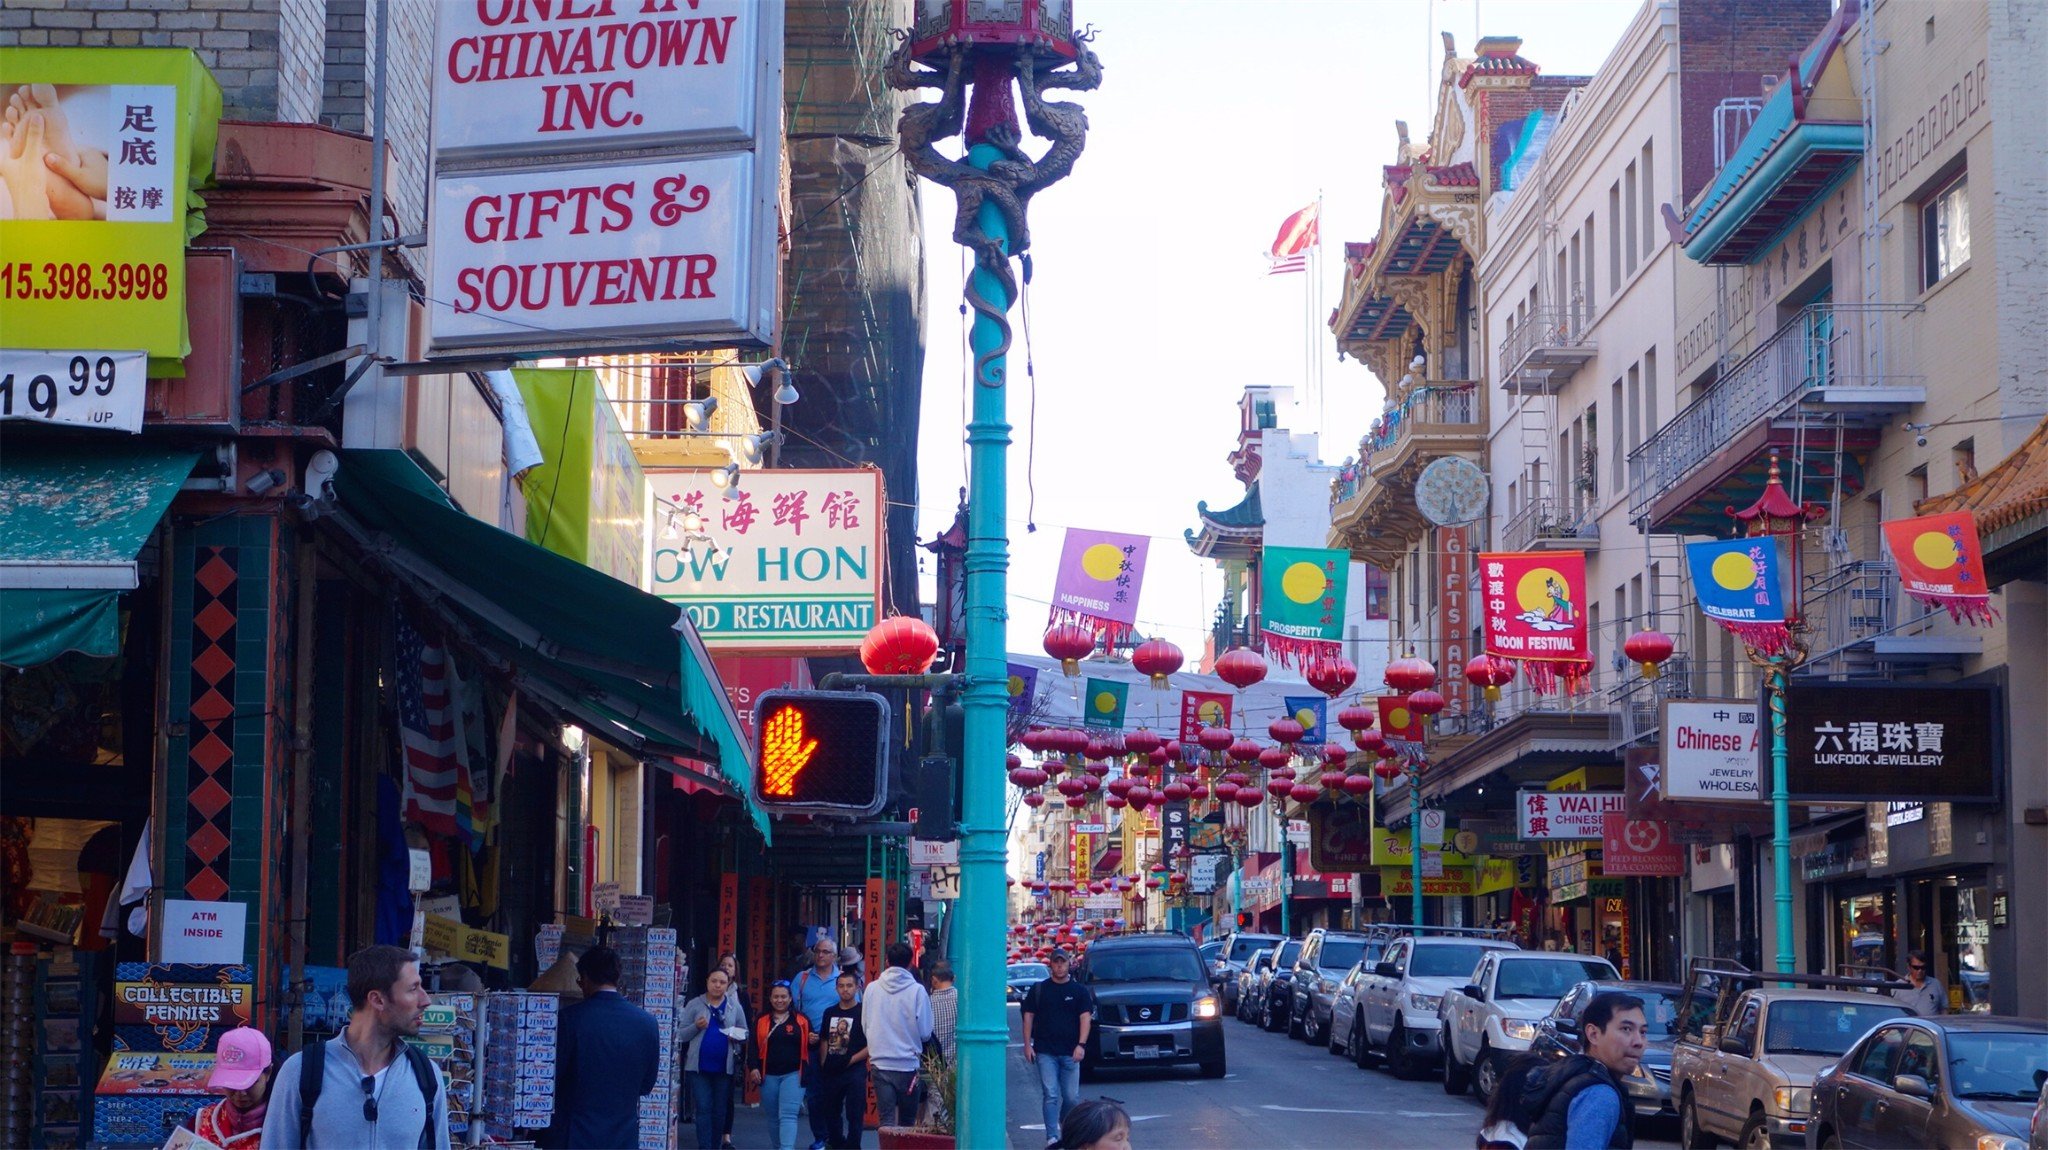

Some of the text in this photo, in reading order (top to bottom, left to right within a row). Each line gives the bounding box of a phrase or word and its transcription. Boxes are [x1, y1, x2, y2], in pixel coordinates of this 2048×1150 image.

[447, 16, 737, 84] CHINATOWN
[538, 80, 644, 132] INC.
[119, 104, 158, 166] 足底
[114, 186, 164, 210] 按摩
[464, 174, 711, 244] GIFTS &
[454, 253, 718, 314] SOUVENIR
[92, 412, 114, 423] UP
[757, 545, 867, 582] HON
[1446, 539, 1462, 624] GIFTS
[1910, 580, 1954, 594] WELCOME
[1061, 593, 1110, 612] HAPPINESS
[1487, 562, 1508, 633] 歡渡中秋
[733, 604, 871, 629] RESTAURANT
[1706, 604, 1756, 618] CELEBRATE
[1268, 620, 1323, 638] PROSPERITY
[1495, 635, 1576, 651] MOON FESTIVAL
[1447, 644, 1463, 714] ARTS
[1713, 710, 1755, 724] 中國
[1677, 726, 1742, 752] Chinese
[1814, 721, 1944, 753] 六福珠寶
[1815, 754, 1944, 766] LUKFOOK JEWELLERY
[1709, 769, 1754, 777] JEWELRY
[1559, 796, 1597, 813] WAI
[1527, 794, 1550, 836] 偉興
[924, 845, 945, 854] TIME
[1393, 882, 1471, 894] JAKETS
[191, 911, 218, 922] ATM
[183, 928, 224, 938] INSIDE
[124, 985, 243, 1005] COLLECTIBLE
[144, 1004, 221, 1022] PENNIES
[529, 1018, 554, 1026] JIMMY
[526, 1084, 551, 1092] JOHN
